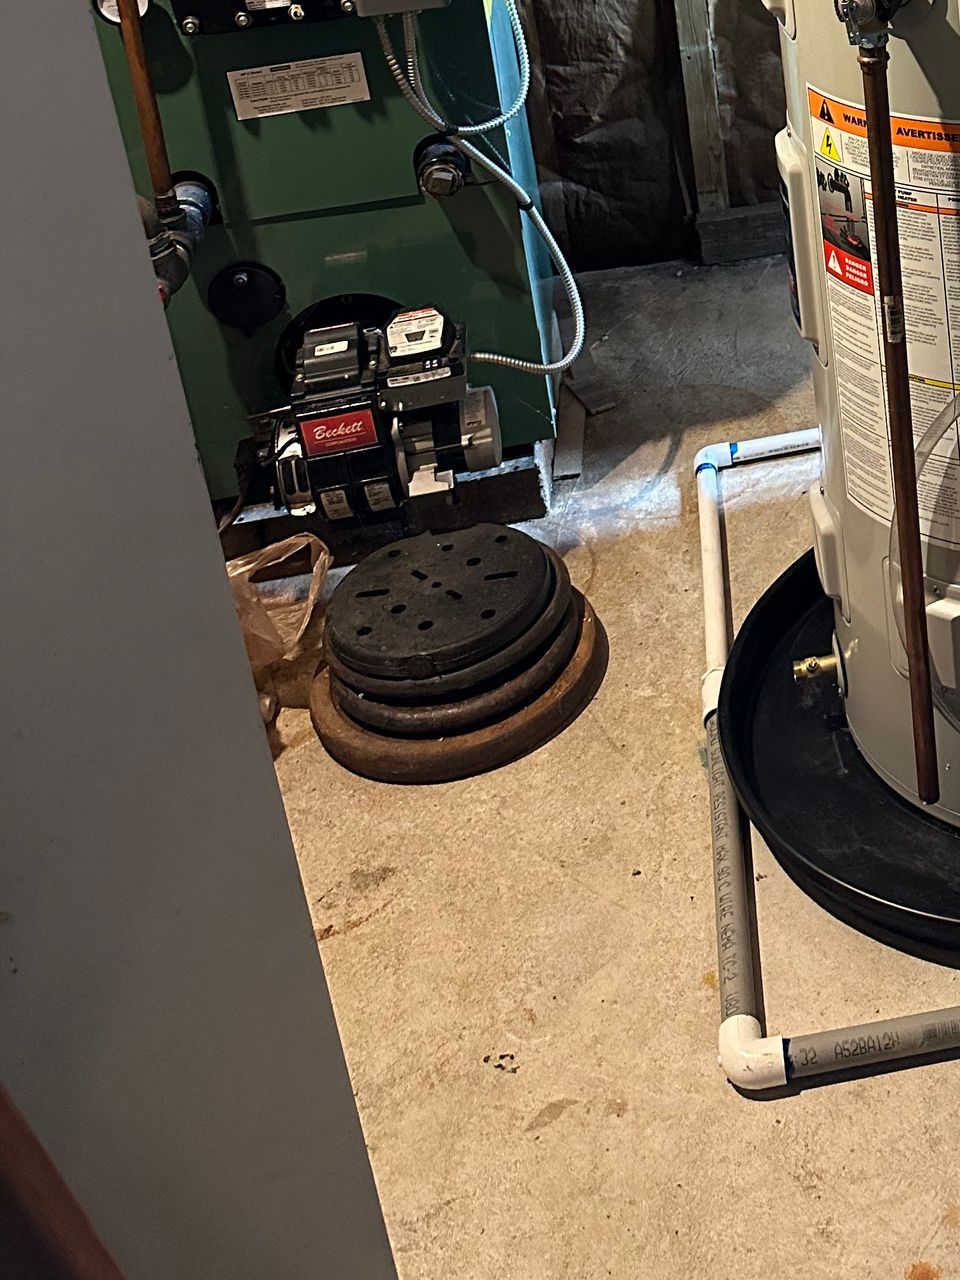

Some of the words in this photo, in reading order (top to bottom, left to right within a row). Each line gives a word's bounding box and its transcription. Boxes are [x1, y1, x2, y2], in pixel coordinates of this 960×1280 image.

[843, 113, 868, 128] WARN
[846, 265, 867, 279] DANGER
[846, 272, 868, 286] PELIGRO
[313, 421, 363, 440] Beckett
[713, 790, 728, 842] RESISTANT
[719, 893, 734, 921] WIRE
[721, 922, 736, 951] NEMA
[724, 952, 739, 985] TC-2
